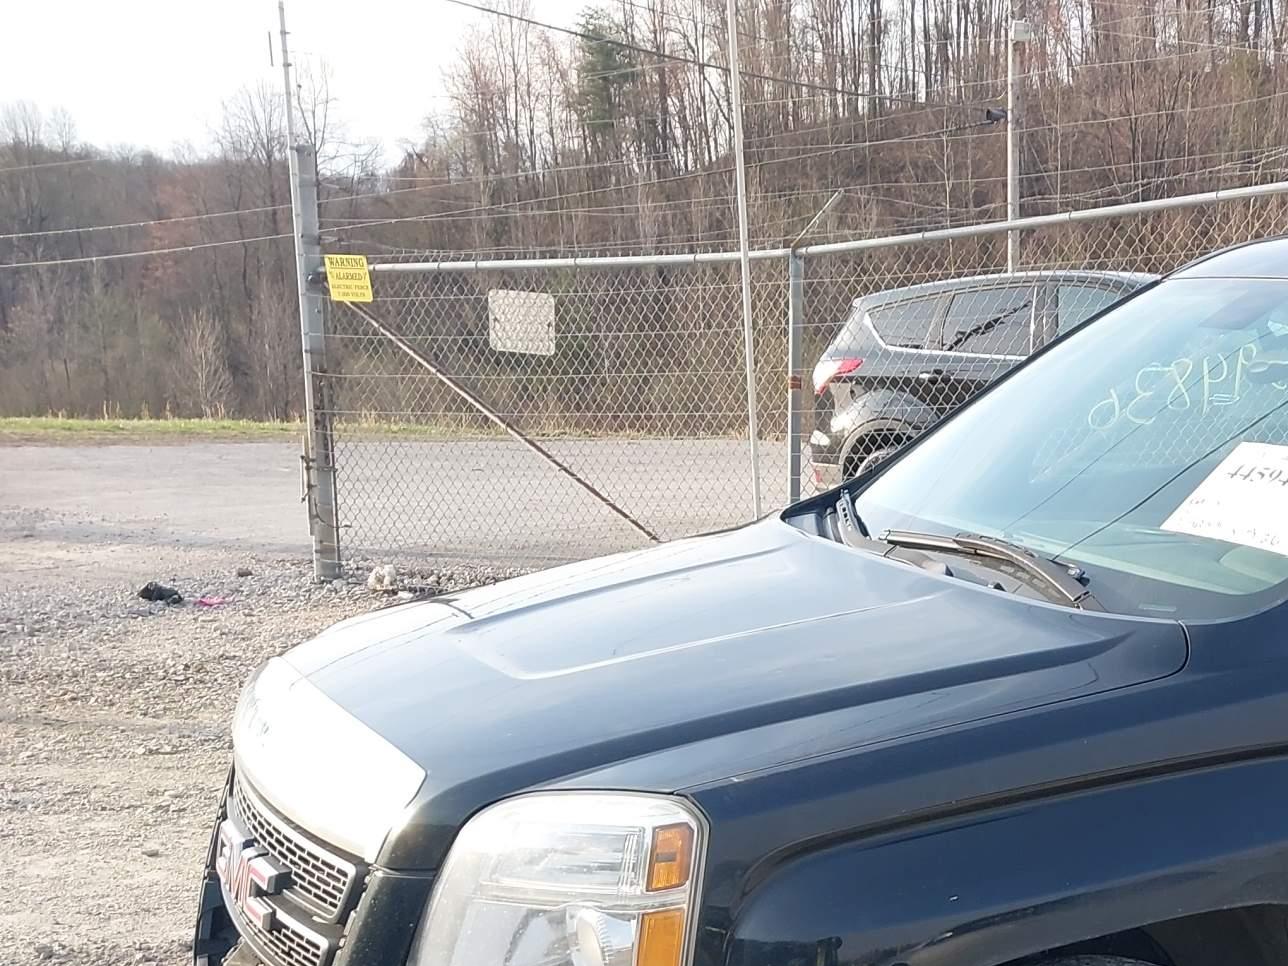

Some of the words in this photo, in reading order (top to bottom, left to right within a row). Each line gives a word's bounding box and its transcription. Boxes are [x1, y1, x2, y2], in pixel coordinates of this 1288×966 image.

[328, 257, 364, 267] WARNING
[335, 272, 363, 281] ALARMED
[216, 820, 282, 932] GMC
